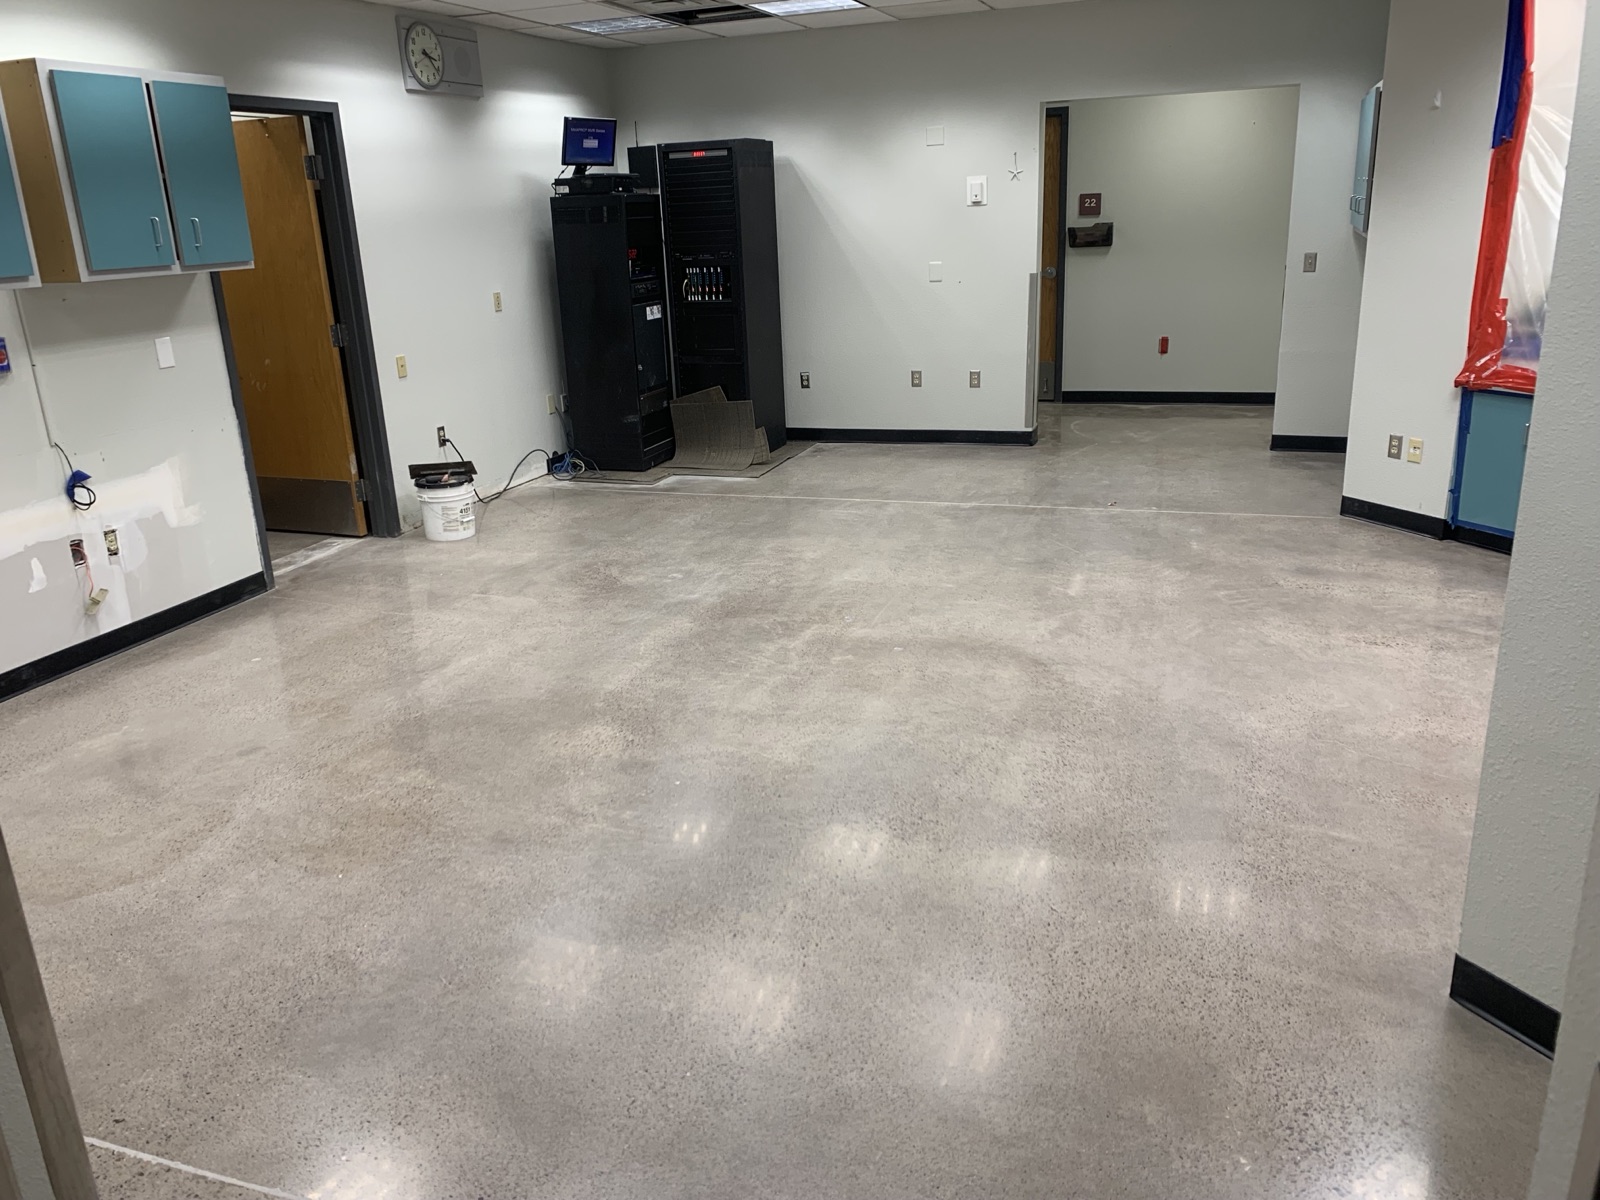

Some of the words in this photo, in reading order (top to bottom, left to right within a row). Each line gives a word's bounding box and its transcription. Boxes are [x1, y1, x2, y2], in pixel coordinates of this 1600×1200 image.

[421, 28, 426, 36] 12
[411, 37, 416, 45] 10
[1084, 198, 1097, 207] 22
